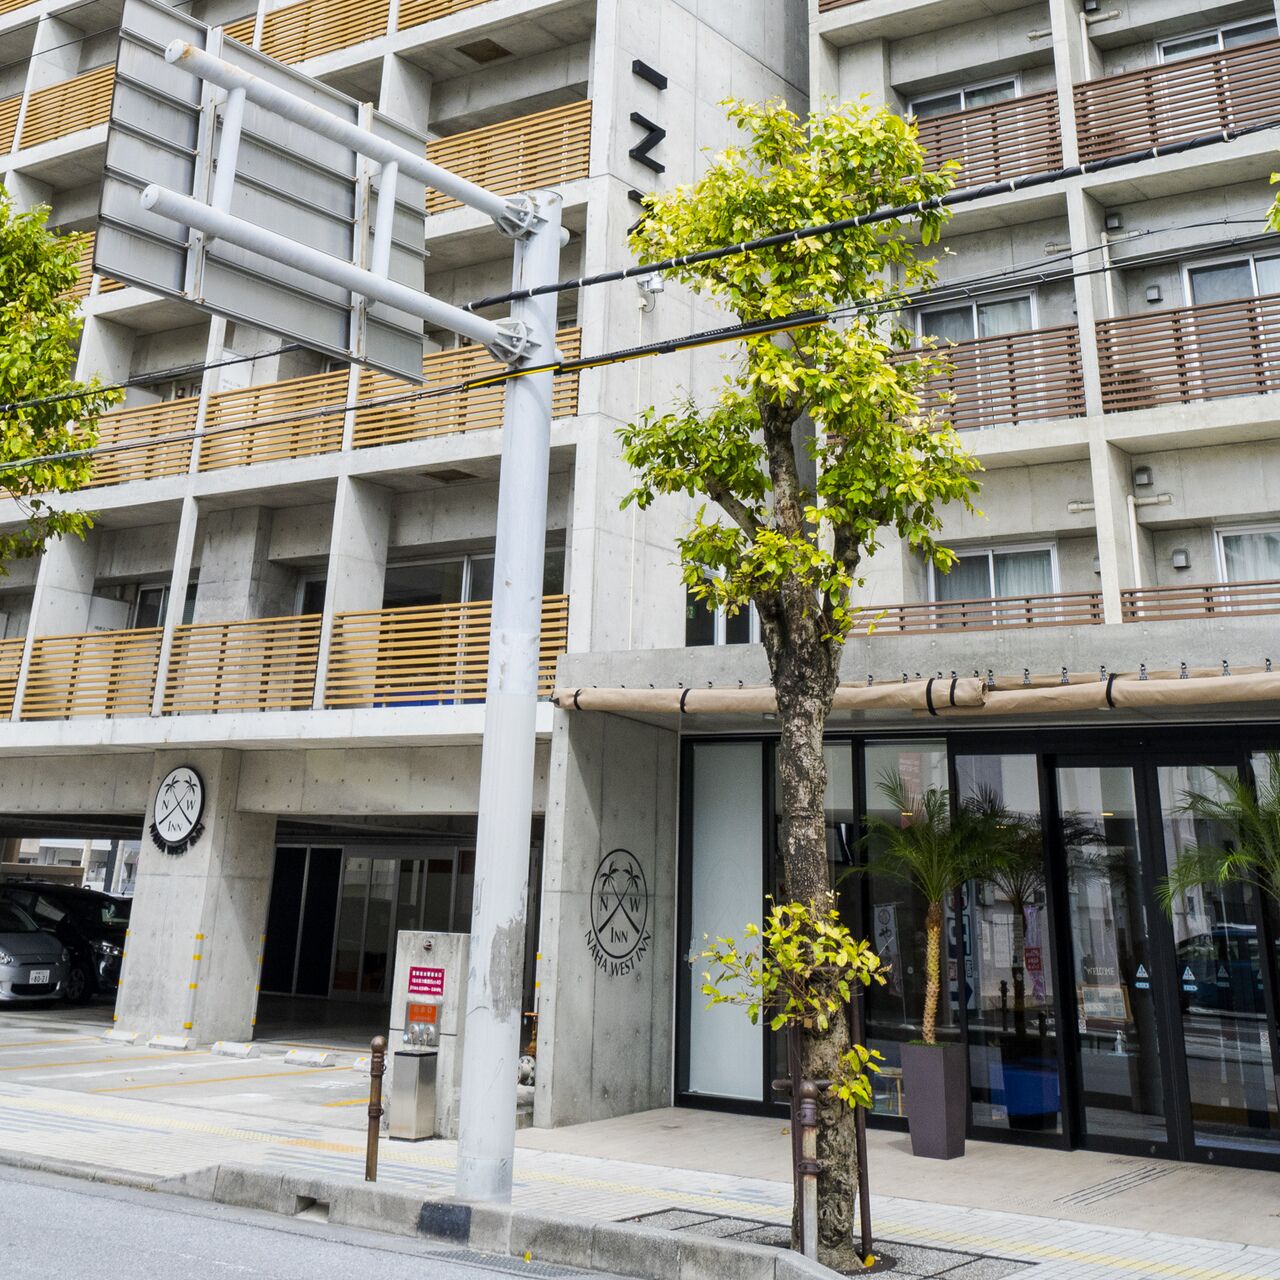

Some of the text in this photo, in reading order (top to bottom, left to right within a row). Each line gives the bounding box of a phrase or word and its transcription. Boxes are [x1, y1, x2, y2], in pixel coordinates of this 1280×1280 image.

[162, 799, 196, 811] N W
[600, 896, 641, 913] N W
[610, 926, 629, 943] INN
[584, 929, 652, 977] NAHA WEST INN
